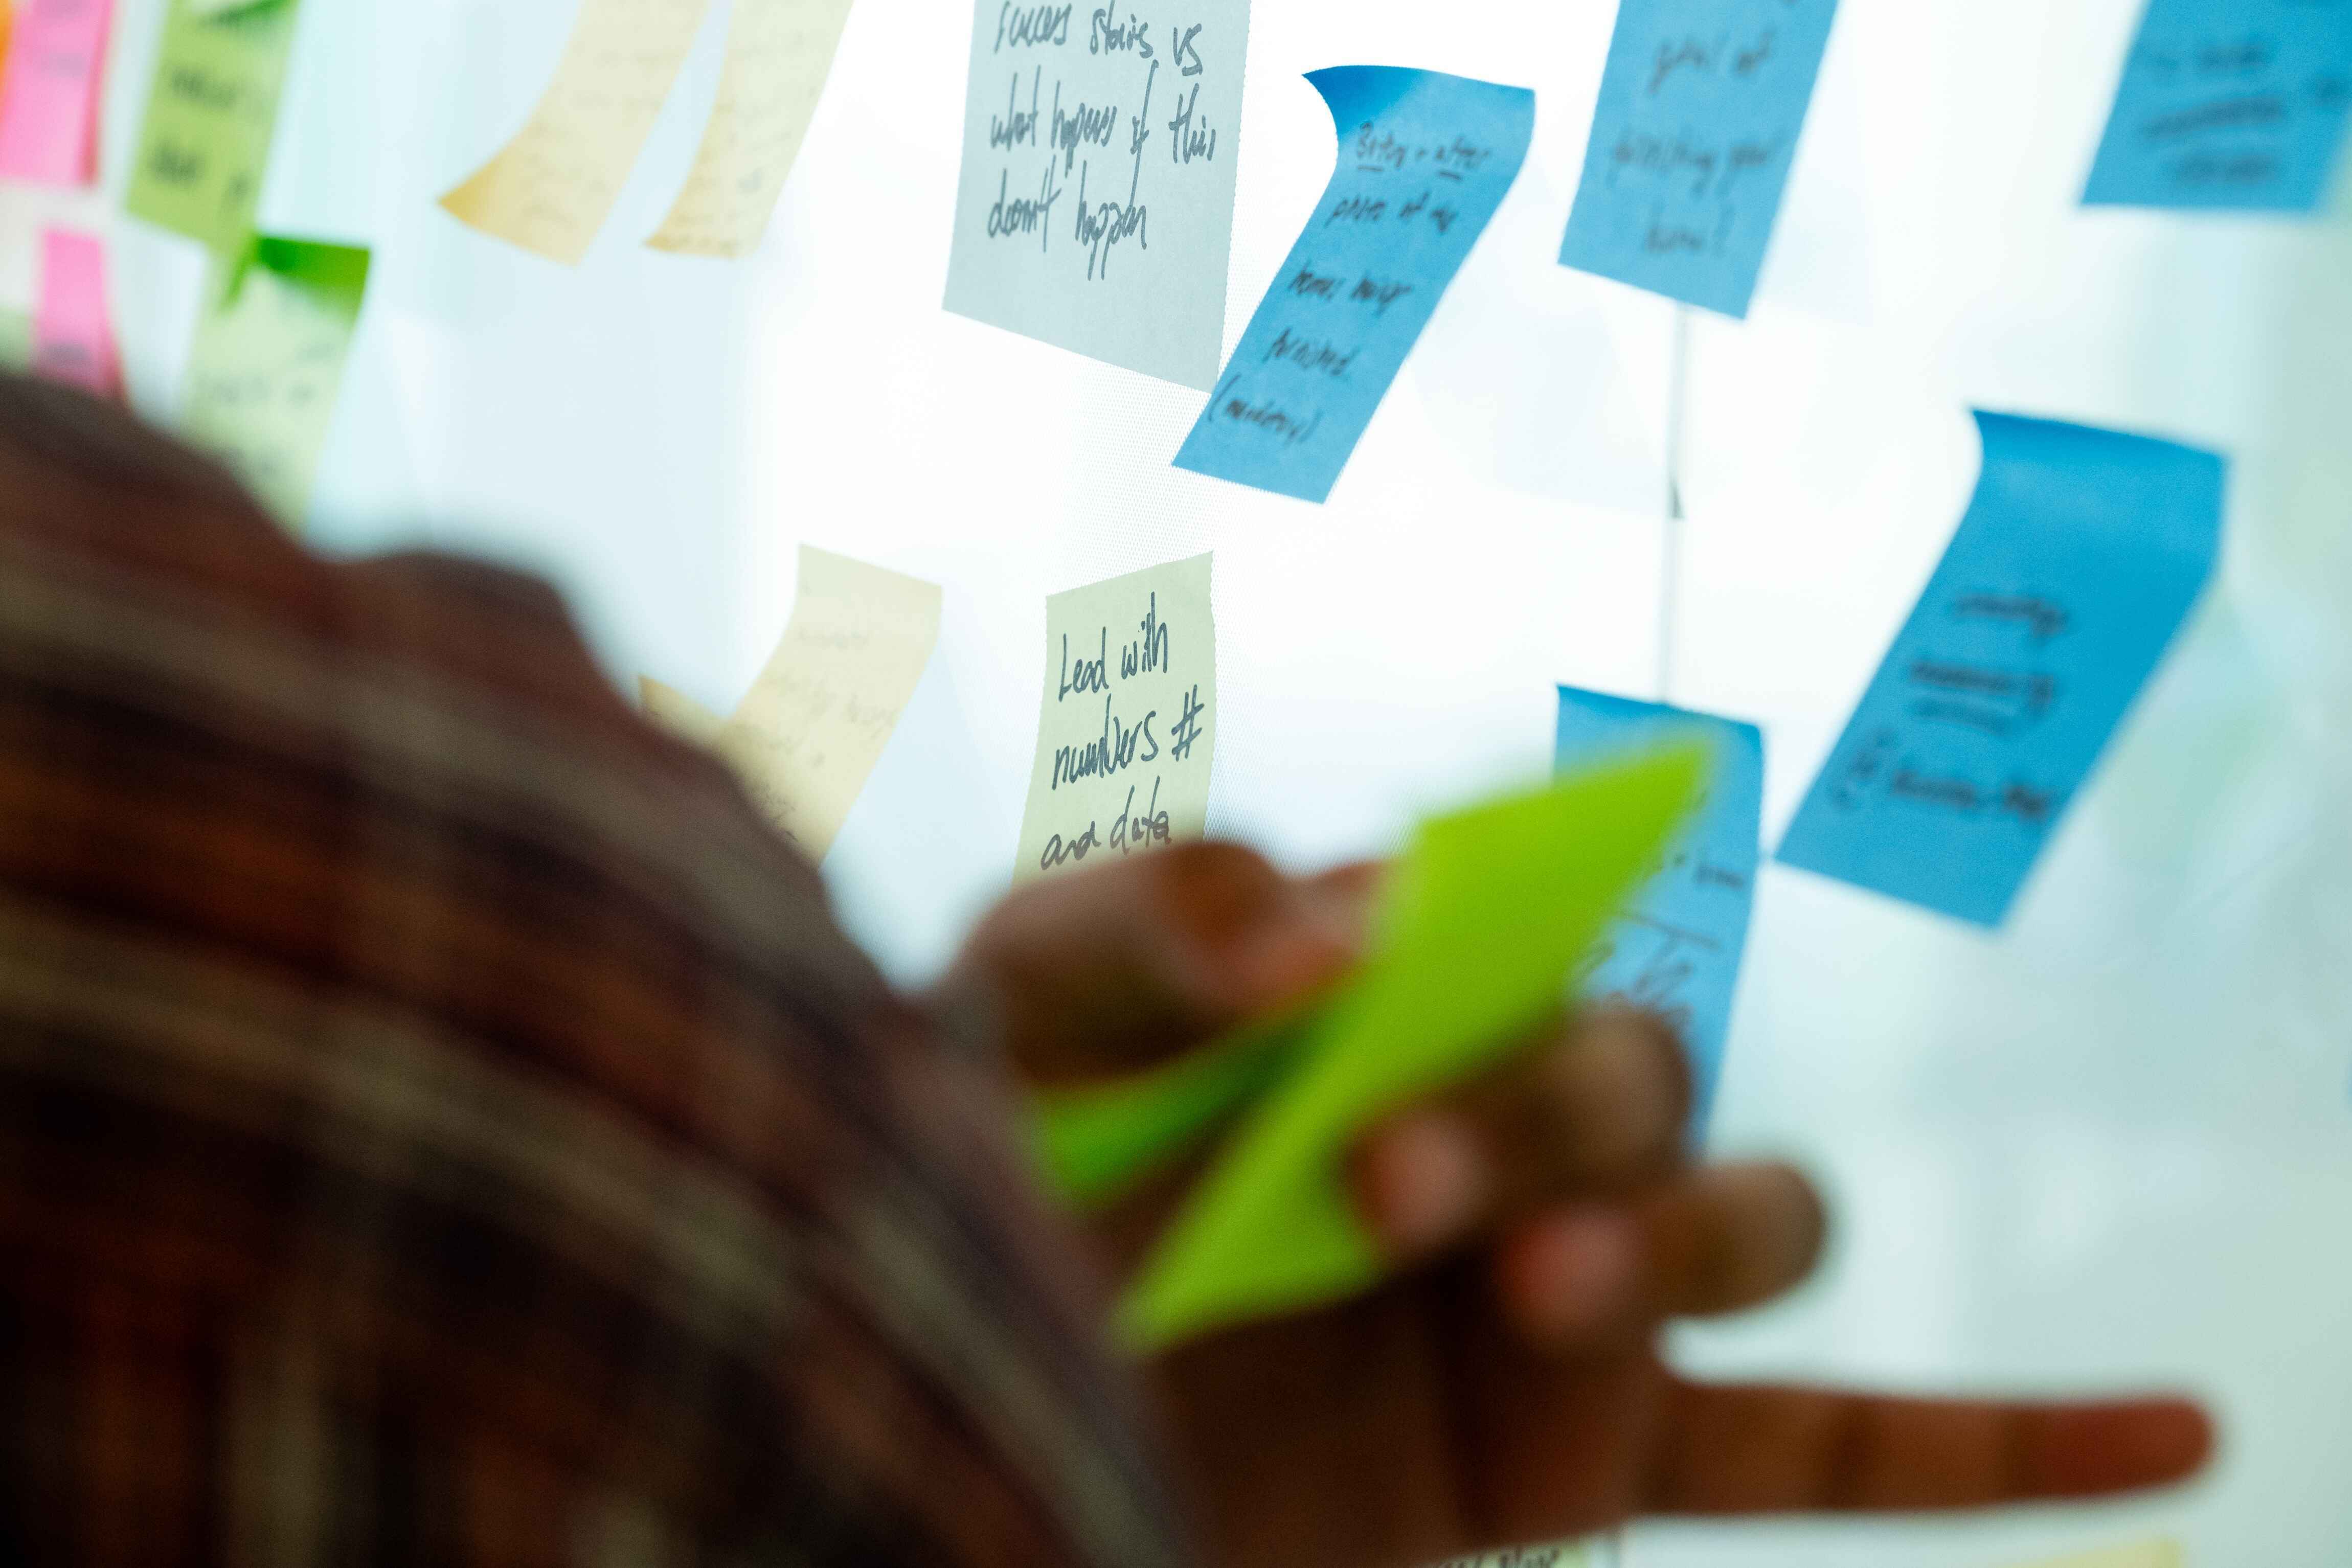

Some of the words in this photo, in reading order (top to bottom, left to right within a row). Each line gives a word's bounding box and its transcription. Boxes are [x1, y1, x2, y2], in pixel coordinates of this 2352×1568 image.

[990, 64, 1041, 151] what
[1051, 80, 1118, 178] happens
[1130, 59, 1159, 206] if
[1168, 83, 1216, 164] this
[1075, 160, 1147, 281] happen
[1058, 626, 1109, 702] Lead
[1121, 592, 1168, 679] with
[1052, 693, 1159, 790] numbers
[1171, 684, 1205, 762] #
[1041, 821, 1101, 870] and
[1110, 775, 1172, 855] data
